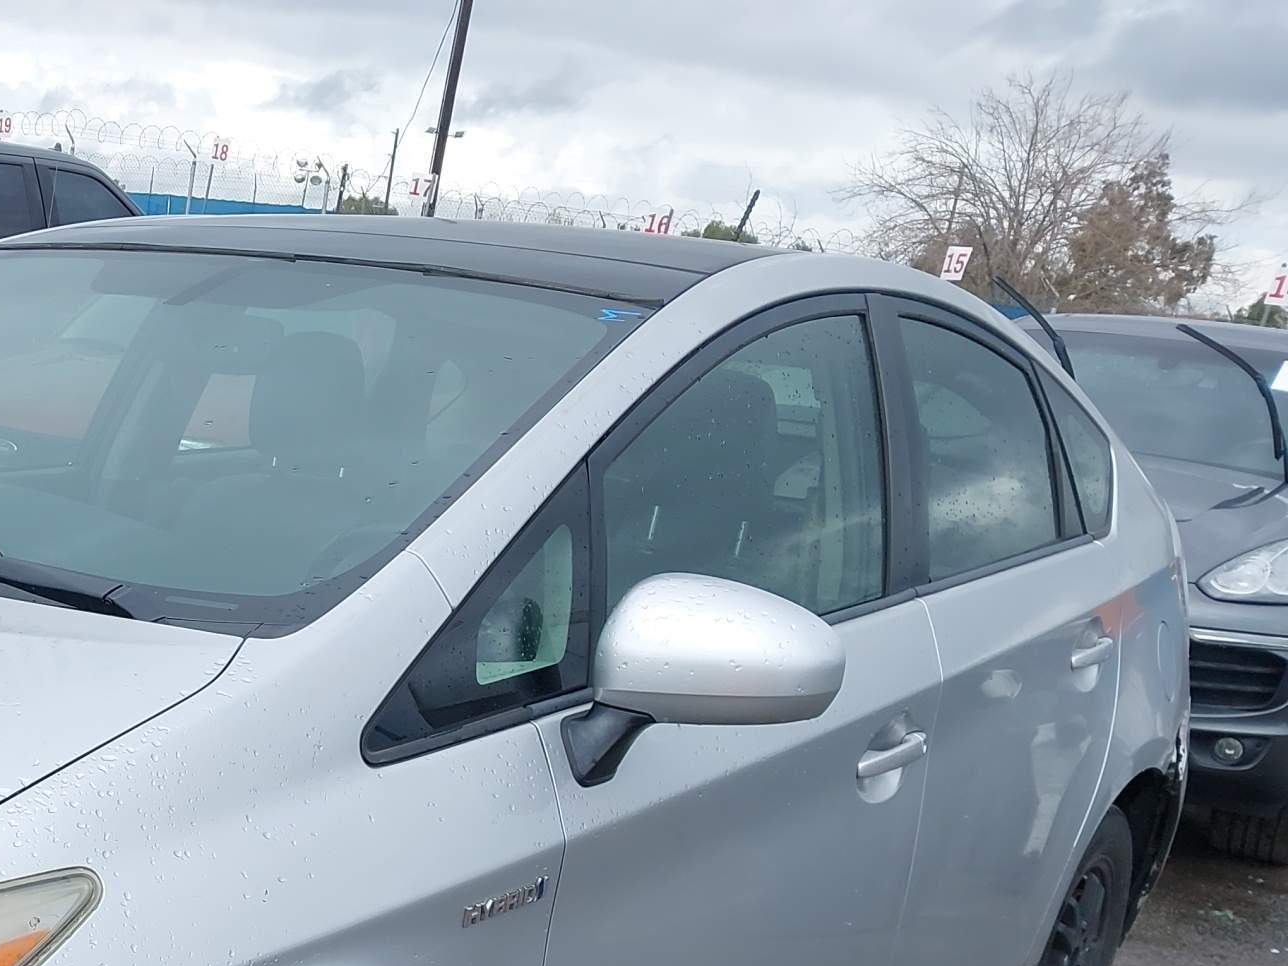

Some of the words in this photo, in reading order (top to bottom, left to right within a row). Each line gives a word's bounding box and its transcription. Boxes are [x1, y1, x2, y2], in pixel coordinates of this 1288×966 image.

[211, 143, 228, 161] 18
[409, 177, 434, 197] 17
[943, 253, 968, 274] 15
